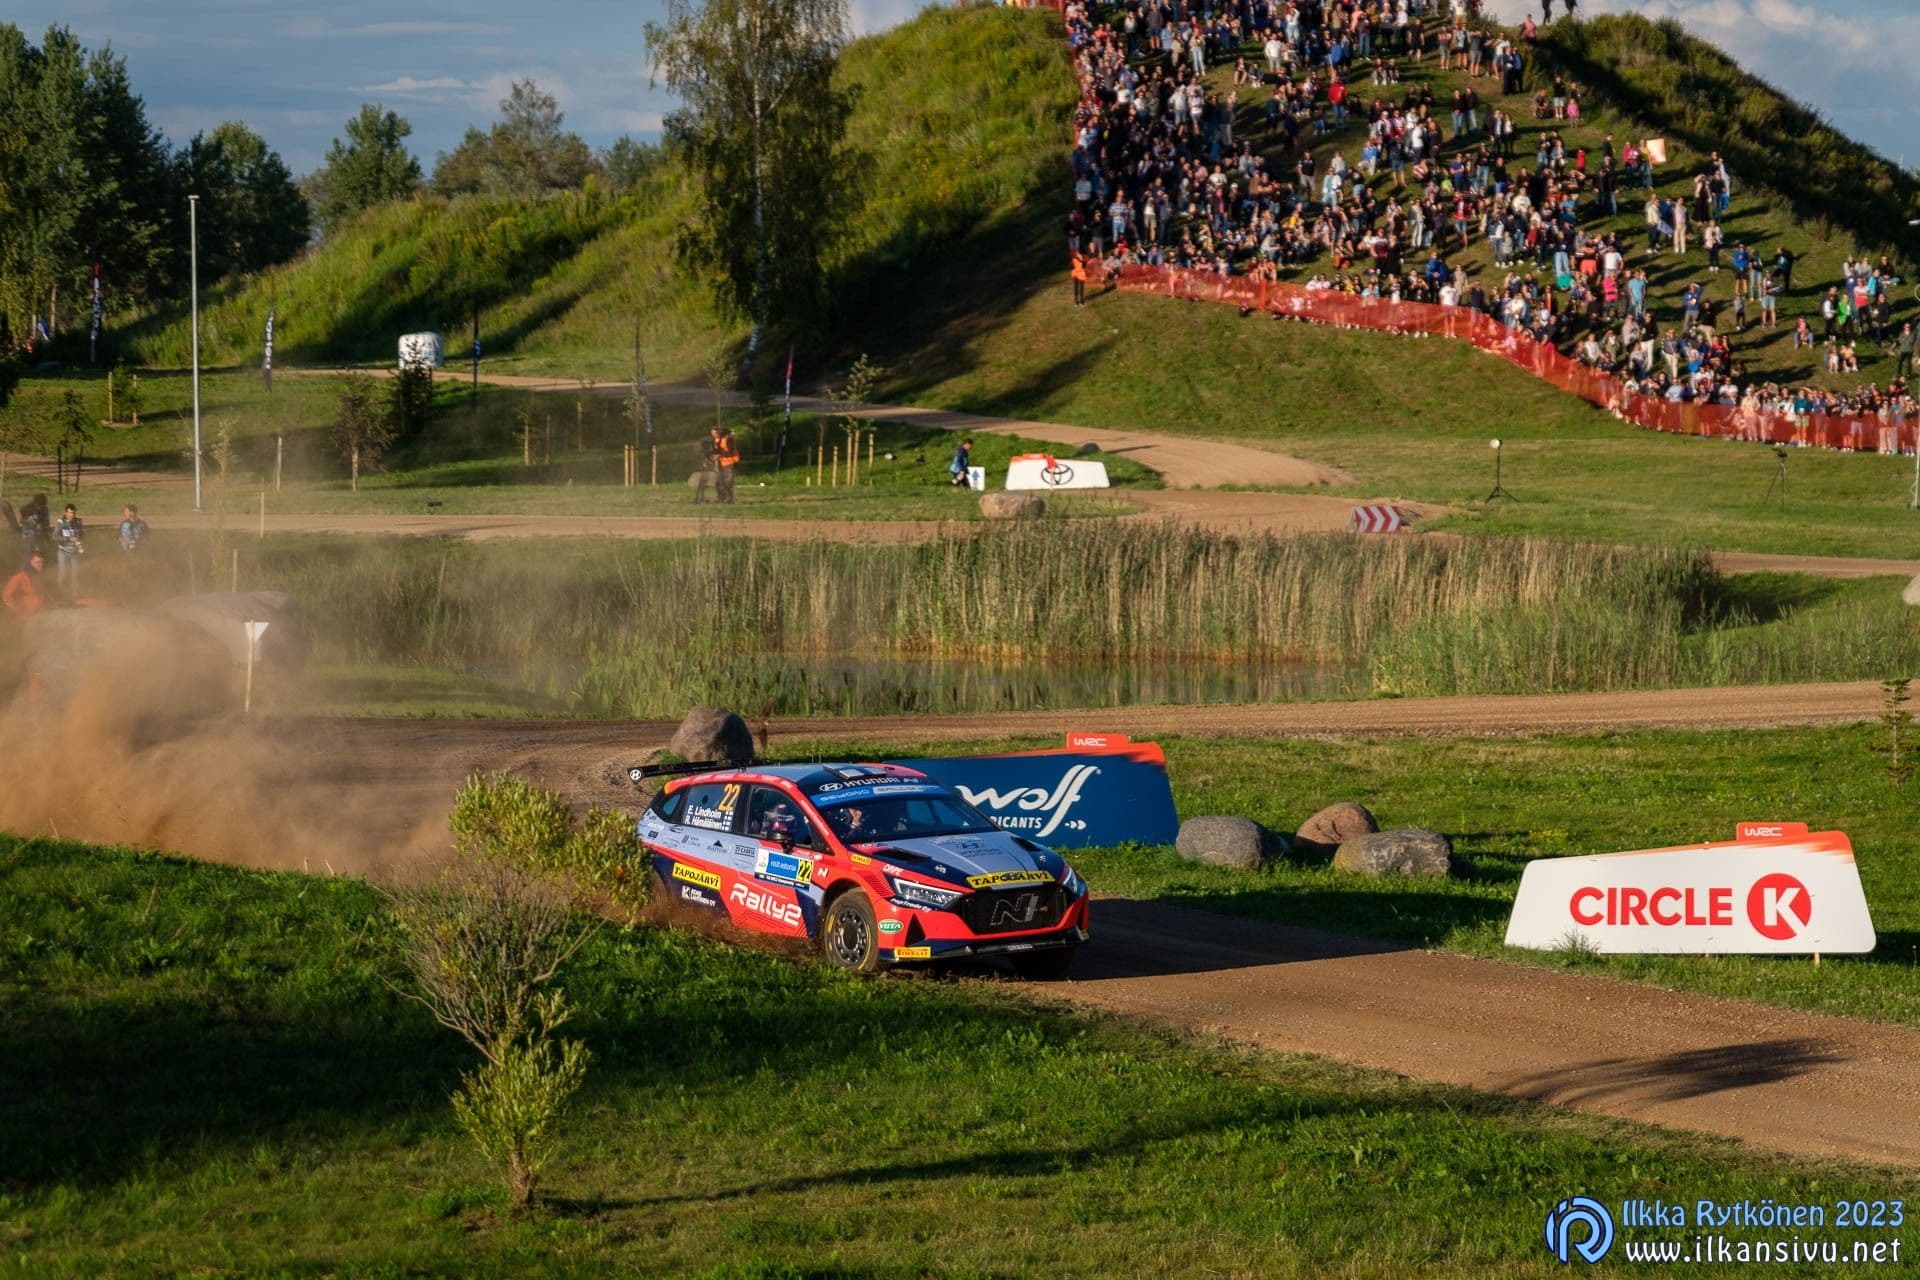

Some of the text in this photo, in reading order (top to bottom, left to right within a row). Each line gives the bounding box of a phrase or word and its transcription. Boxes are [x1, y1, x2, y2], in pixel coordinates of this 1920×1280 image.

[1073, 737, 1107, 747] WRC
[842, 777, 900, 787] HYUNDAI
[718, 783, 741, 811] 22
[695, 806, 722, 819] Lindholm
[1744, 826, 1783, 837] WRC
[674, 866, 719, 887] TAPOJÄRVI
[798, 860, 812, 882] 22
[817, 867, 829, 878] N
[971, 871, 1049, 886] TAPOÄRVI
[729, 882, 802, 927] Rally2
[1569, 883, 1808, 938] CIRCLE K
